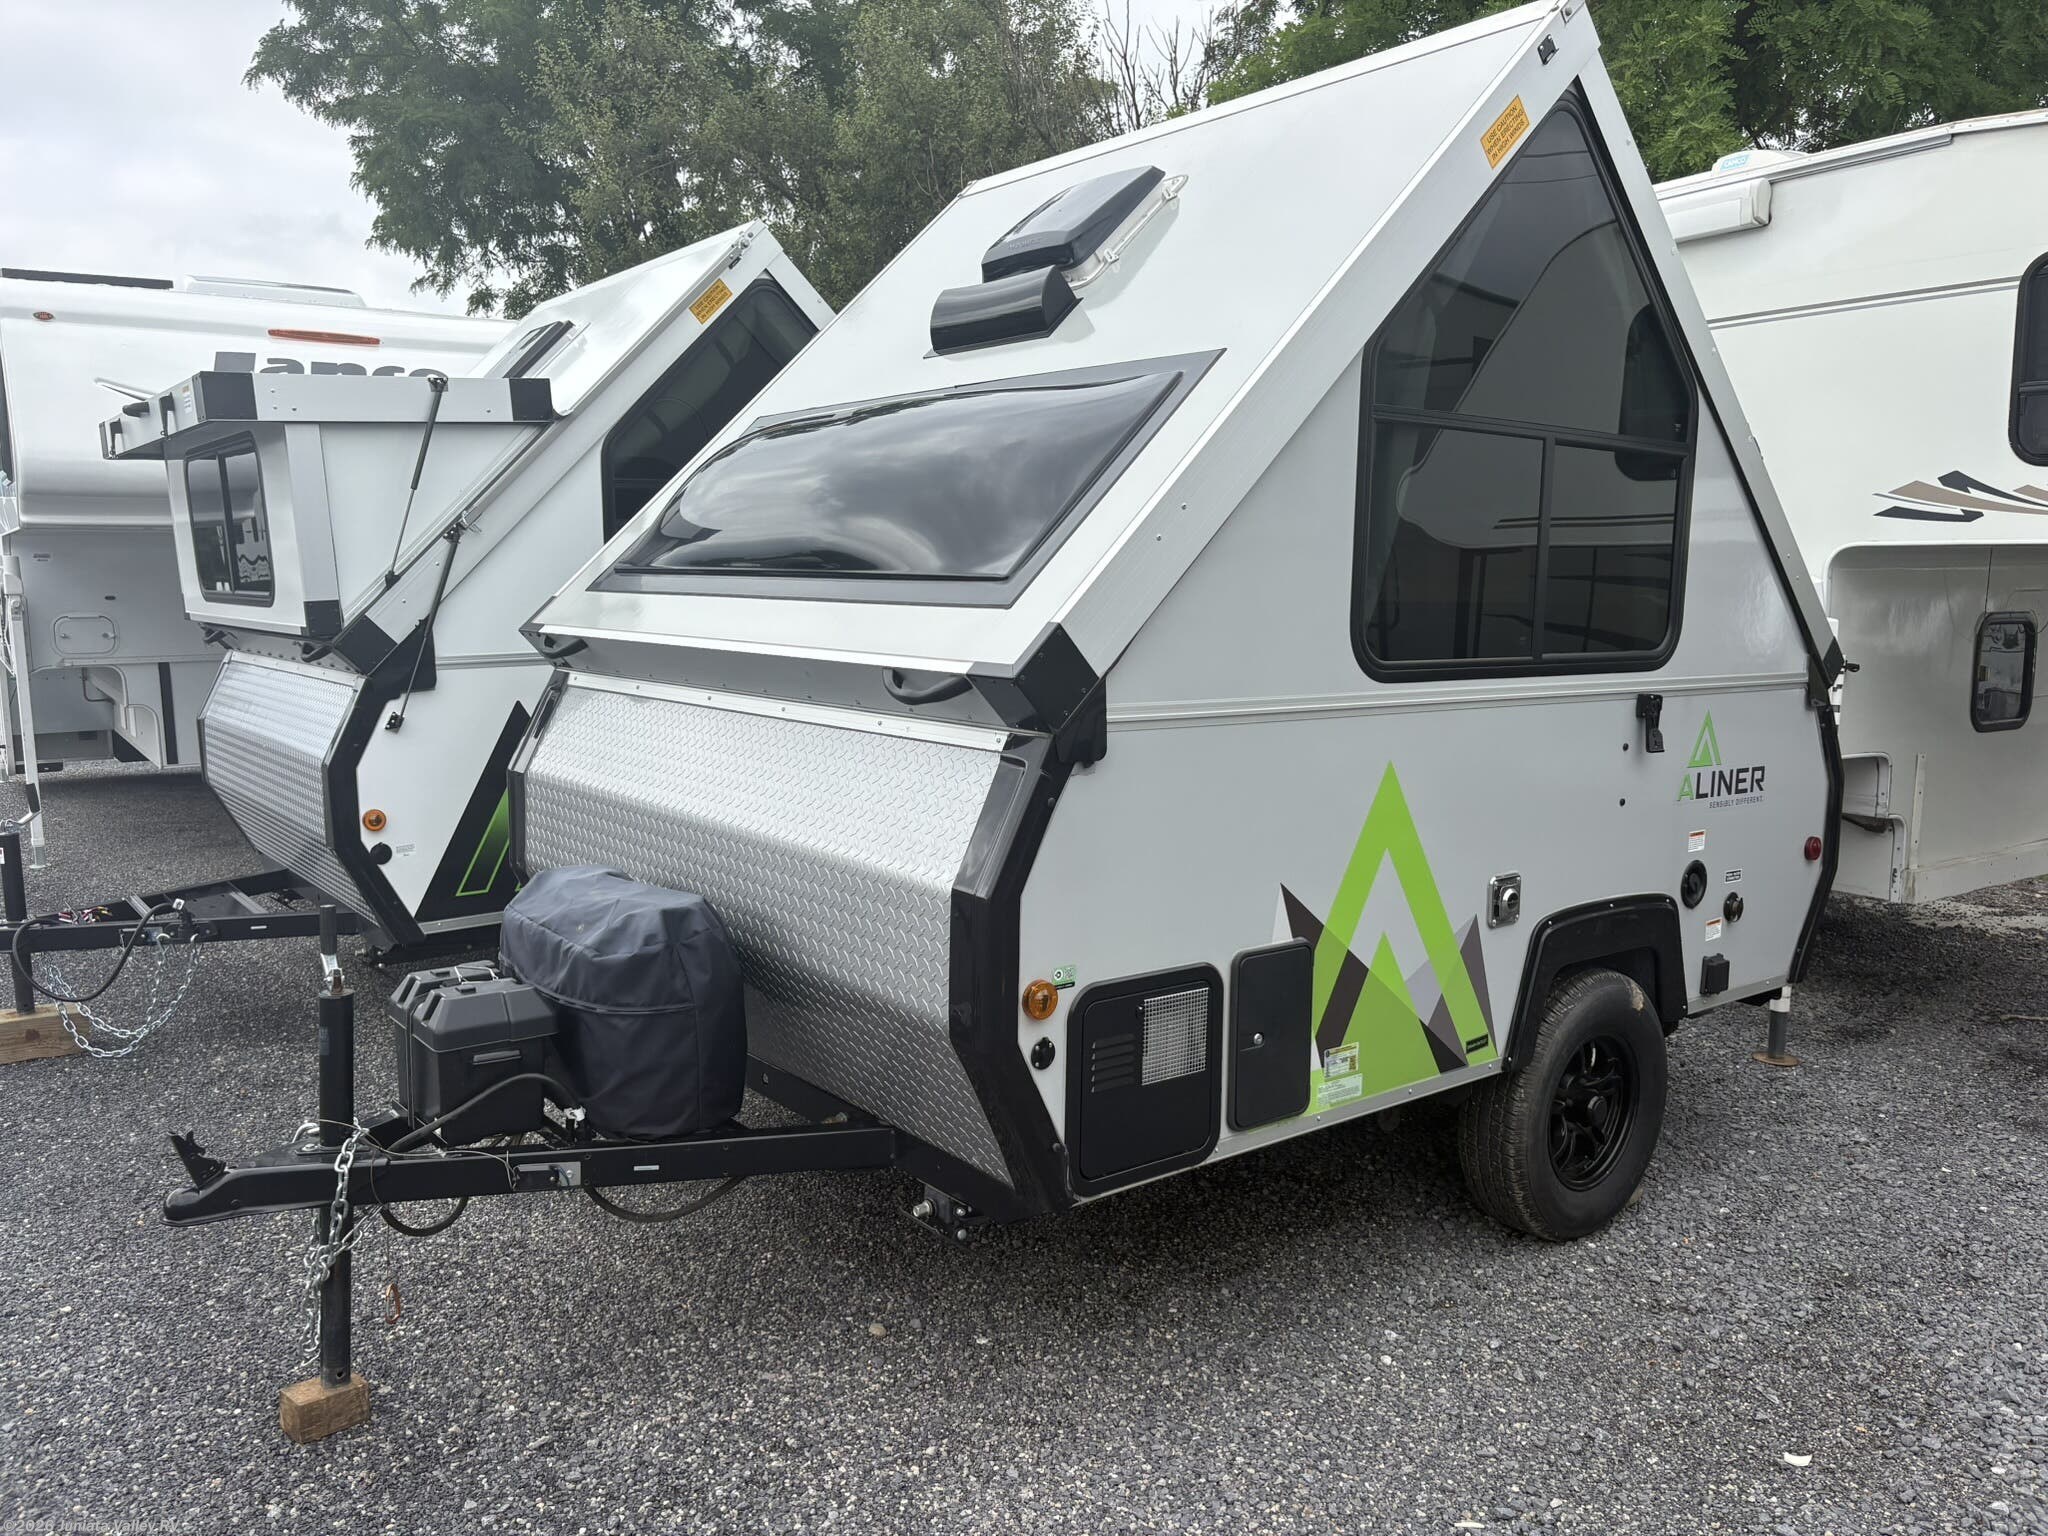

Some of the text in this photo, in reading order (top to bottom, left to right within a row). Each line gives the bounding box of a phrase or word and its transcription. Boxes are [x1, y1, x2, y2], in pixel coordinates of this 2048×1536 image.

[1486, 103, 1517, 144] USE CAUTION
[1487, 107, 1523, 155] WHEN ERECTING
[1676, 766, 1765, 801] ALINER
[1709, 799, 1734, 808] SENSIBLY
